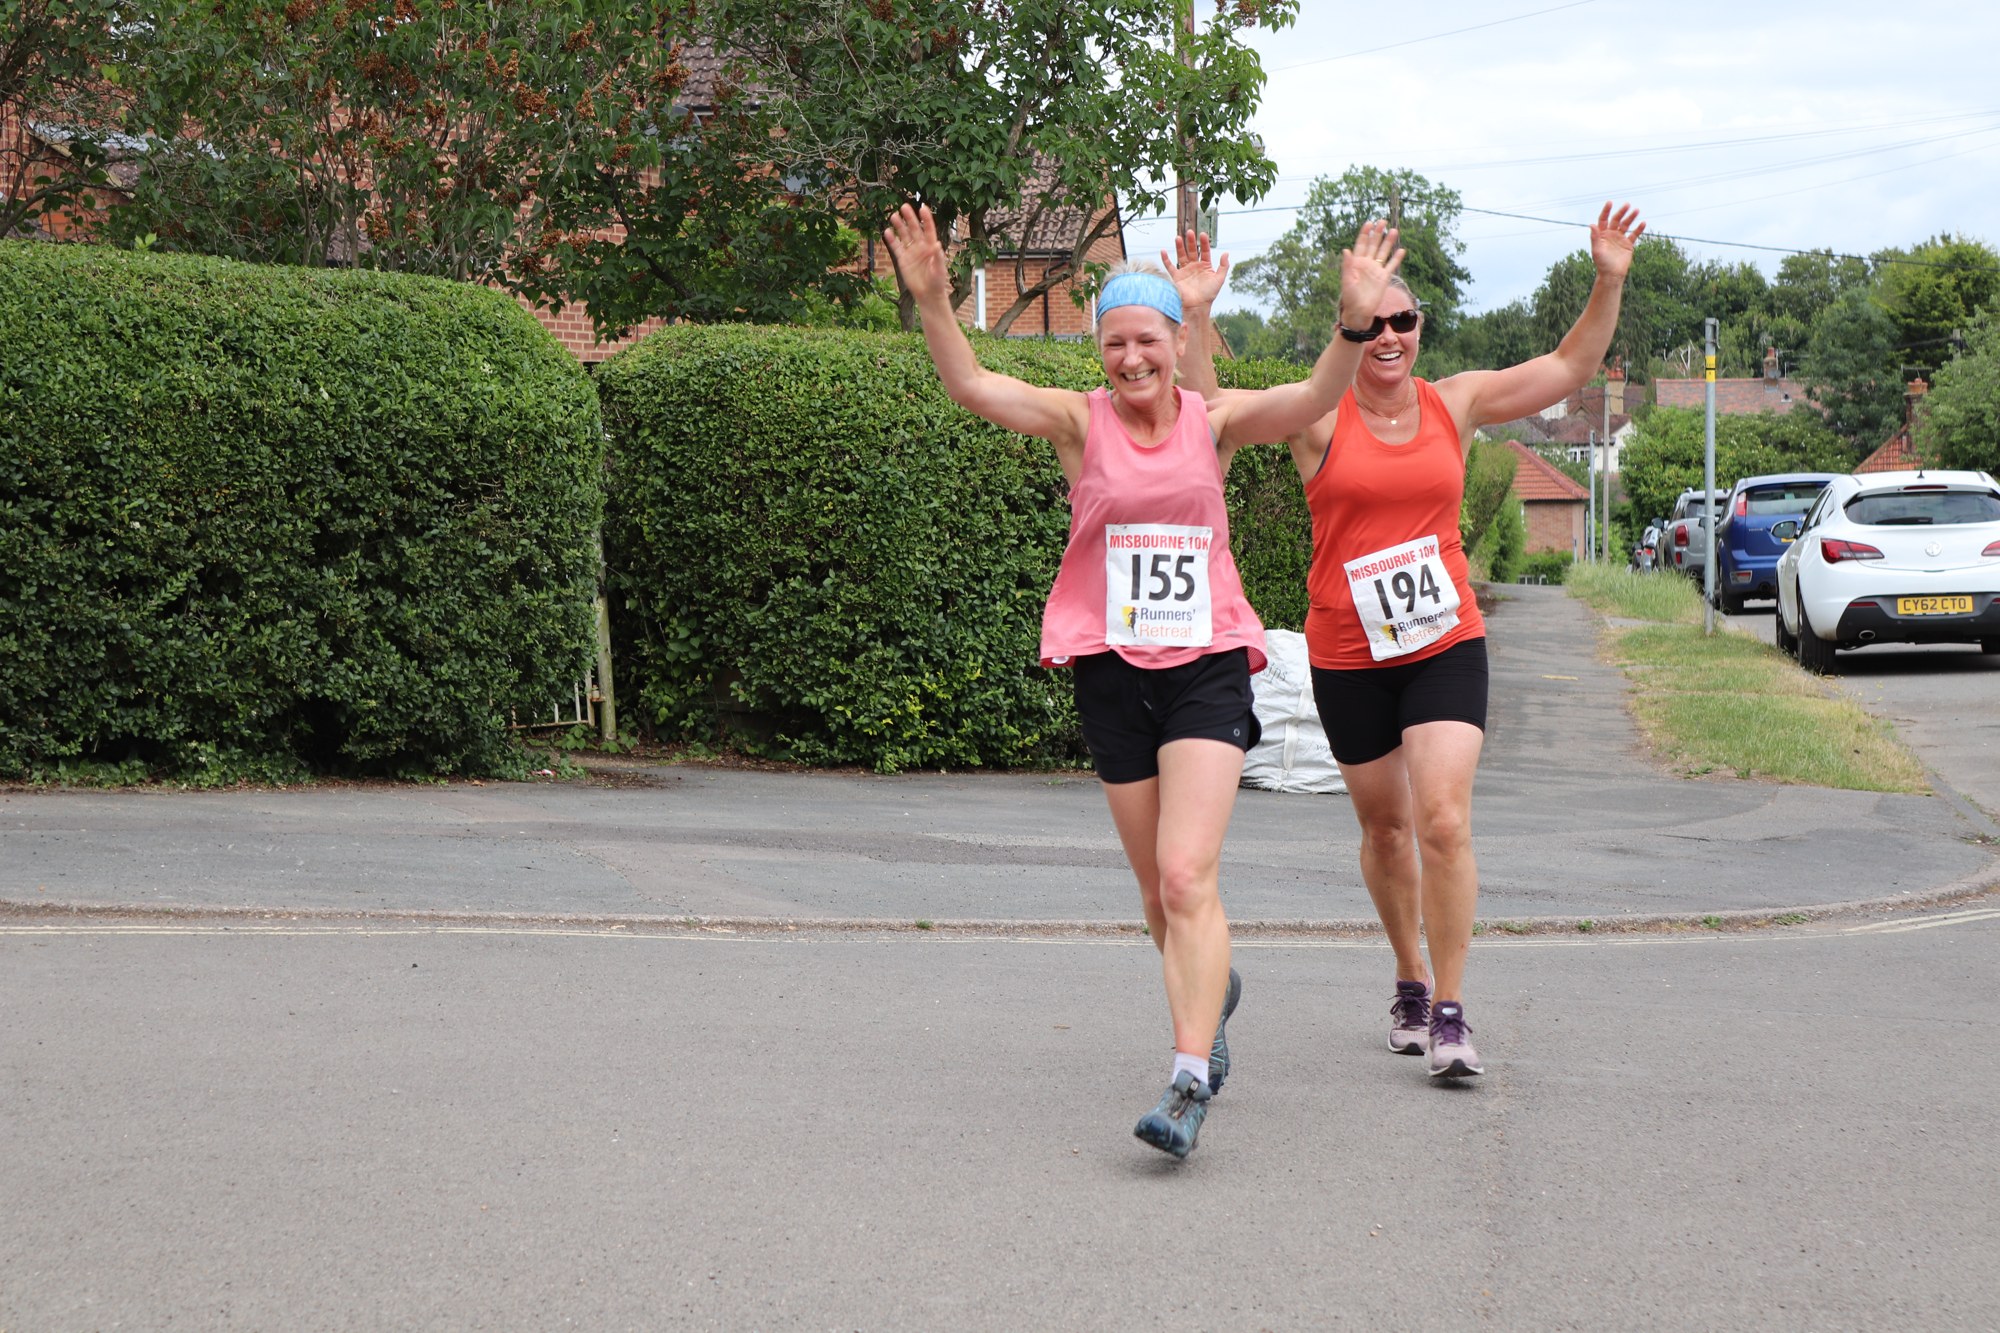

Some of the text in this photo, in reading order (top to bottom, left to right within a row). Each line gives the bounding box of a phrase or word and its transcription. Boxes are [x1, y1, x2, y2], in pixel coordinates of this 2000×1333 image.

[1109, 534, 1210, 550] MISBOURNE 10K
[1350, 544, 1437, 582] MISBOURNE 10K
[1130, 554, 1195, 602] 155
[1373, 563, 1441, 621] 194
[1140, 607, 1196, 622] Runners'
[1903, 597, 1967, 611] CY62 CTO
[1139, 624, 1193, 638] Retreat
[1402, 620, 1445, 647] Retreat
